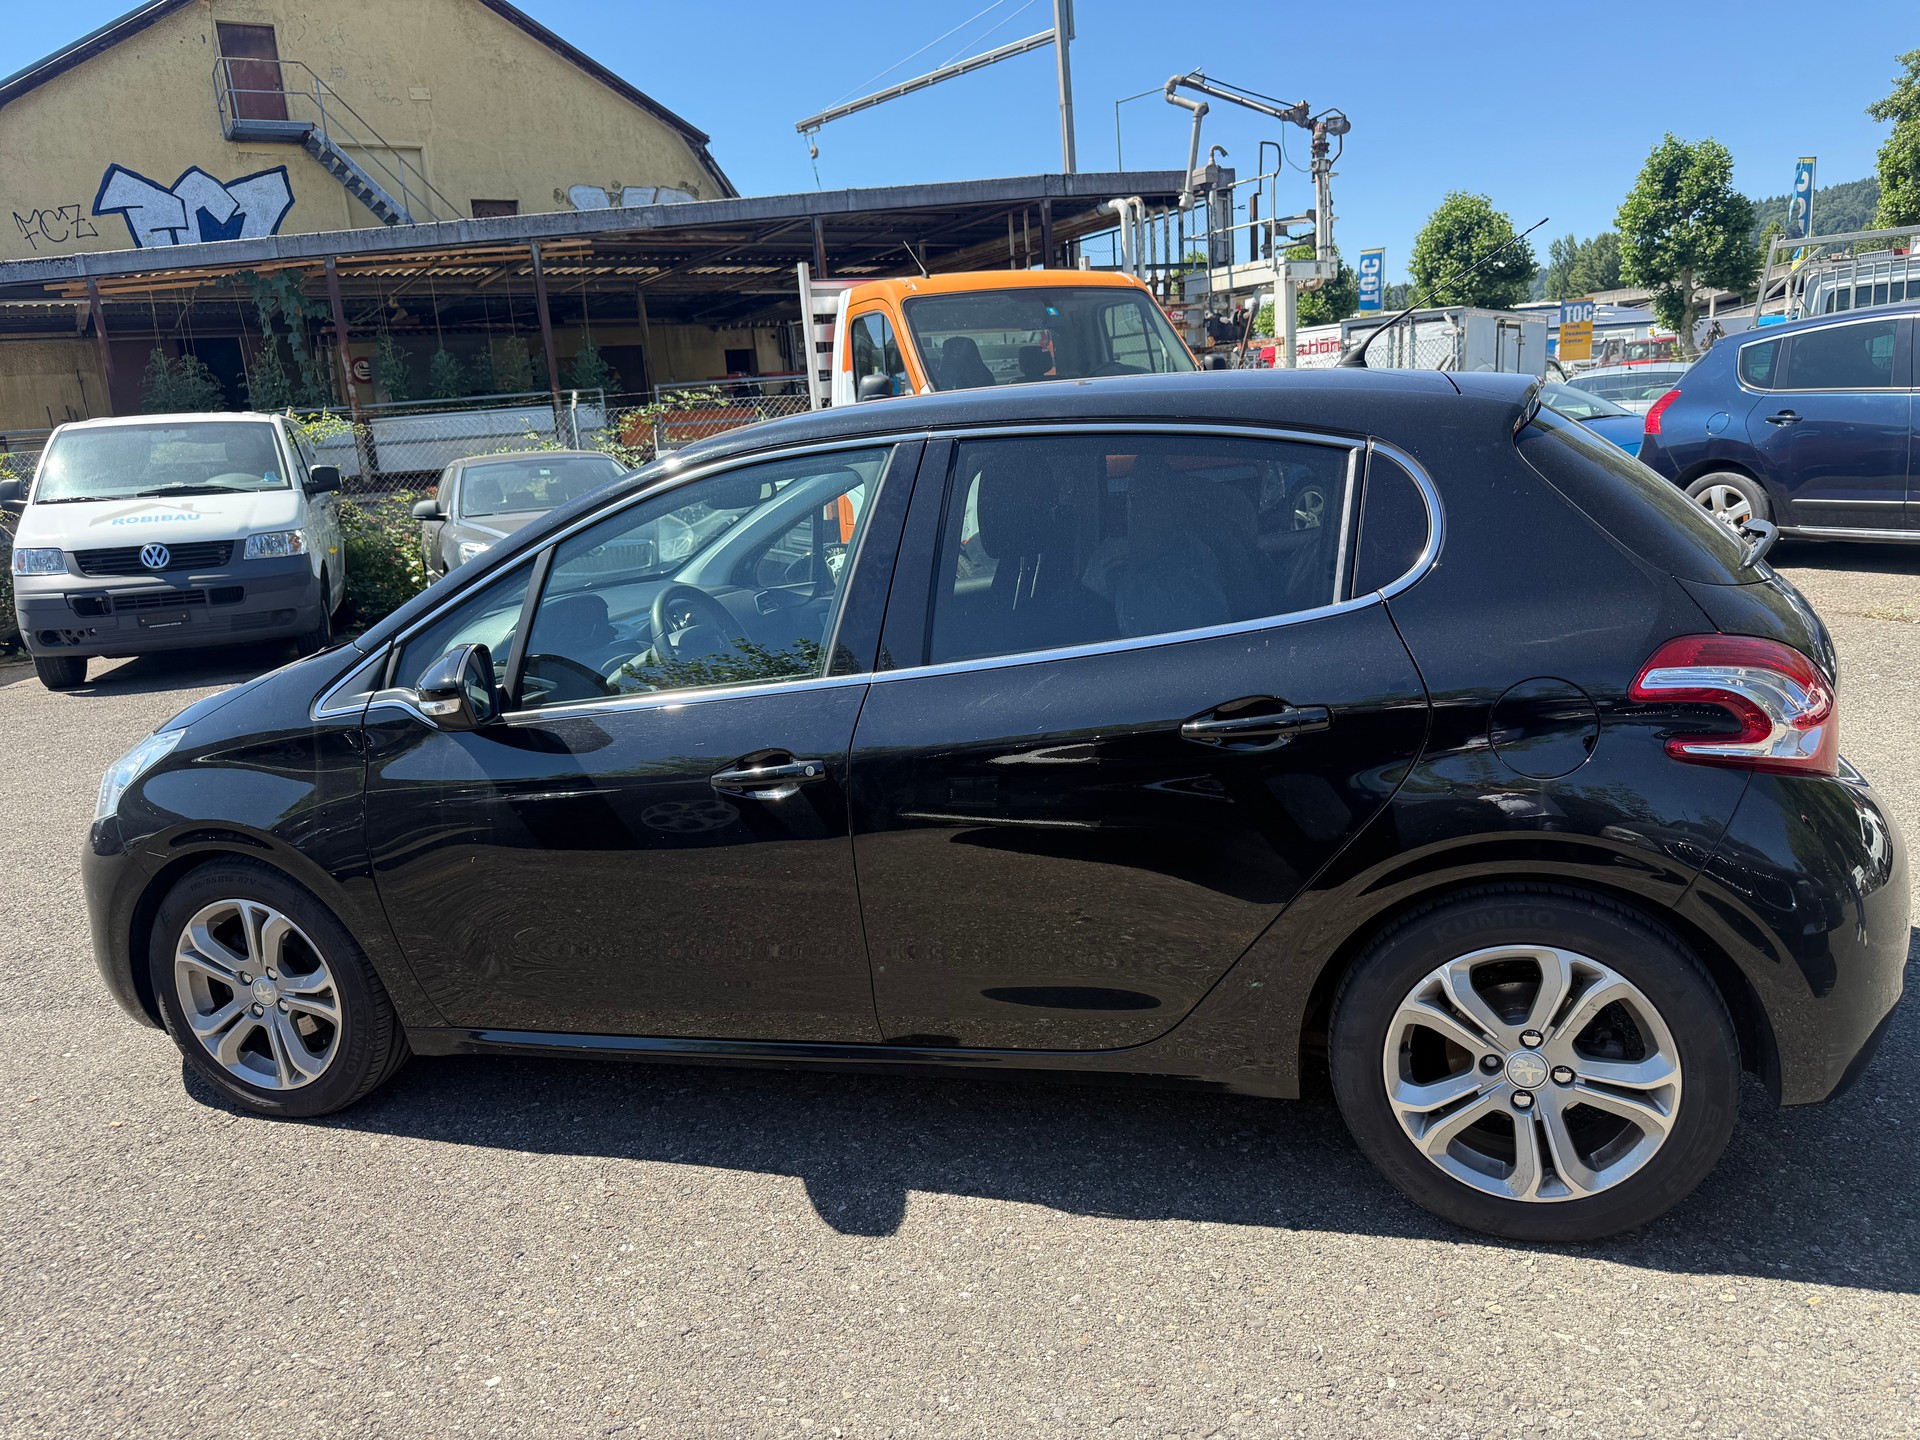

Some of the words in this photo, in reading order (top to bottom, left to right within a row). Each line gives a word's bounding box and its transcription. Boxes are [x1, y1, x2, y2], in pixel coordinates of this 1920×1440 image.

[1565, 304, 1592, 323] TOC
[111, 513, 201, 526] ROBIBAU
[1433, 910, 1556, 941] KUMHO
